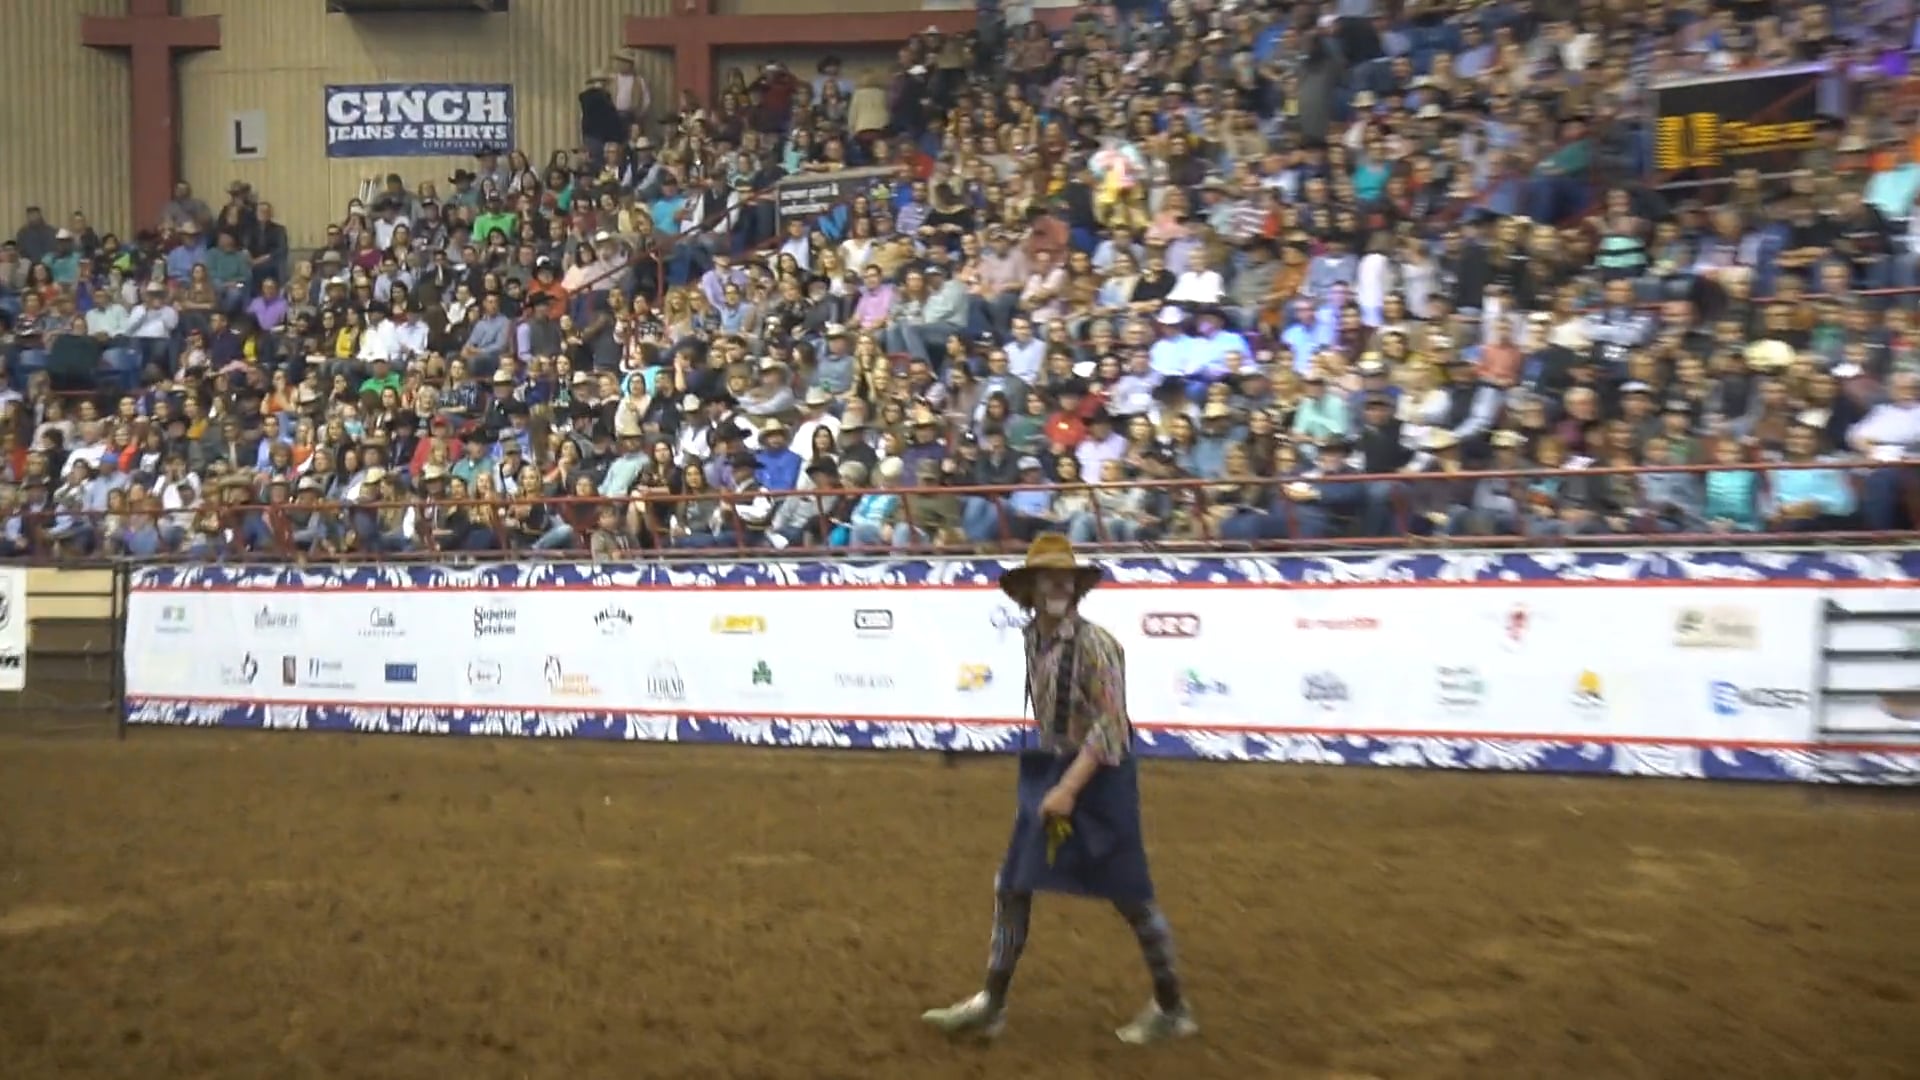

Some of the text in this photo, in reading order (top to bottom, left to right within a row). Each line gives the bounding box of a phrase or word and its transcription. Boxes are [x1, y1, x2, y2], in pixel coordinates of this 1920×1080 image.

[327, 90, 507, 124] CINCH
[235, 120, 258, 154] L
[329, 124, 507, 144] JEANS & SHIRTS
